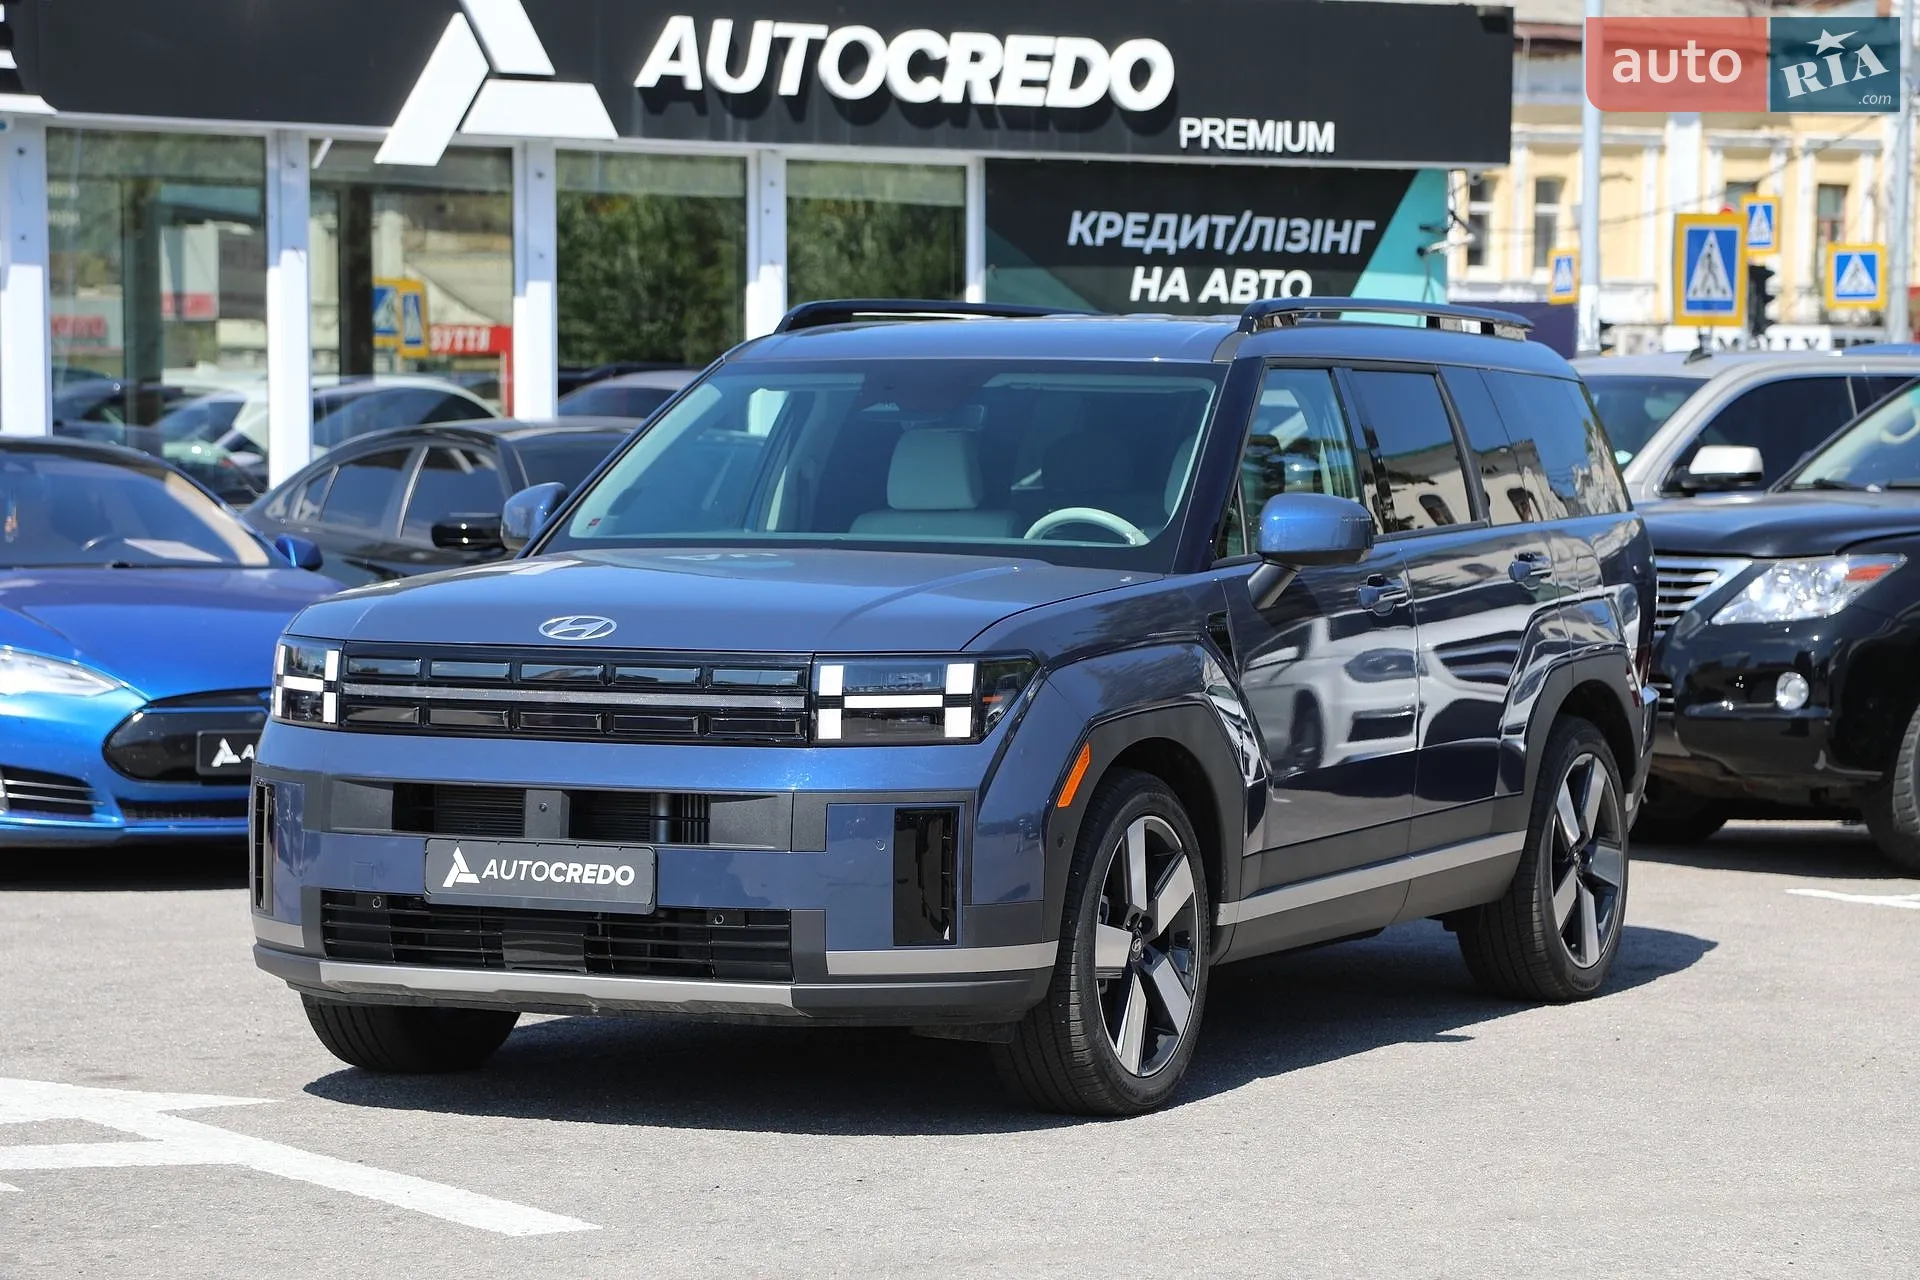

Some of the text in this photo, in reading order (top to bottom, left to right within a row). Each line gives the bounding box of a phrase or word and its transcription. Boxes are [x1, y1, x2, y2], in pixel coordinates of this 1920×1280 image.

[634, 15, 1175, 112] AUTOCREDO
[1179, 117, 1336, 154] PREMIUM
[1067, 210, 1377, 255] КРЕДИТ/ЛІЗІНГ
[1130, 266, 1313, 305] НА АВТО
[481, 858, 636, 887] AUTOCREDO
